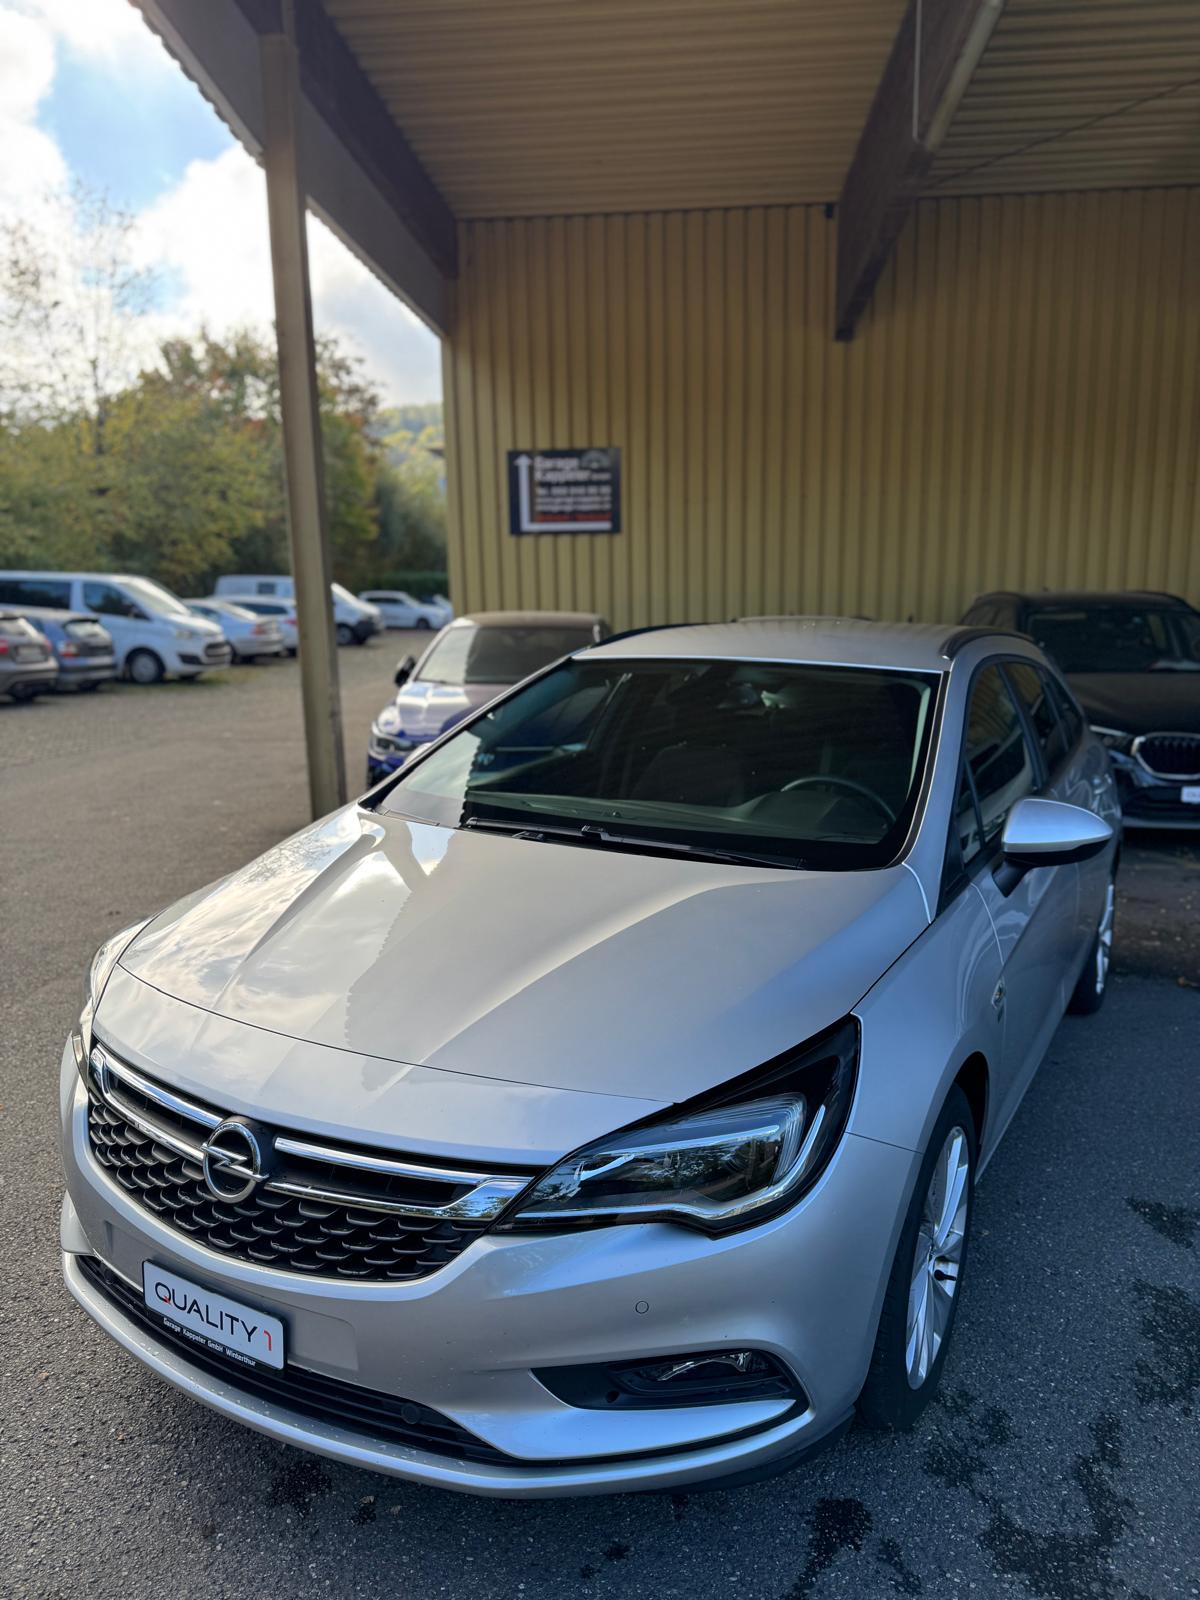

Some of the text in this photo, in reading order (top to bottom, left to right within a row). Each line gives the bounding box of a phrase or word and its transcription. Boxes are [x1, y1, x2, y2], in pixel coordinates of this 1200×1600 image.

[155, 1281, 272, 1352] QUALITY 1
[163, 1317, 181, 1332] Garage
[207, 1339, 223, 1353] GmbH
[225, 1347, 256, 1367] Winterthur
